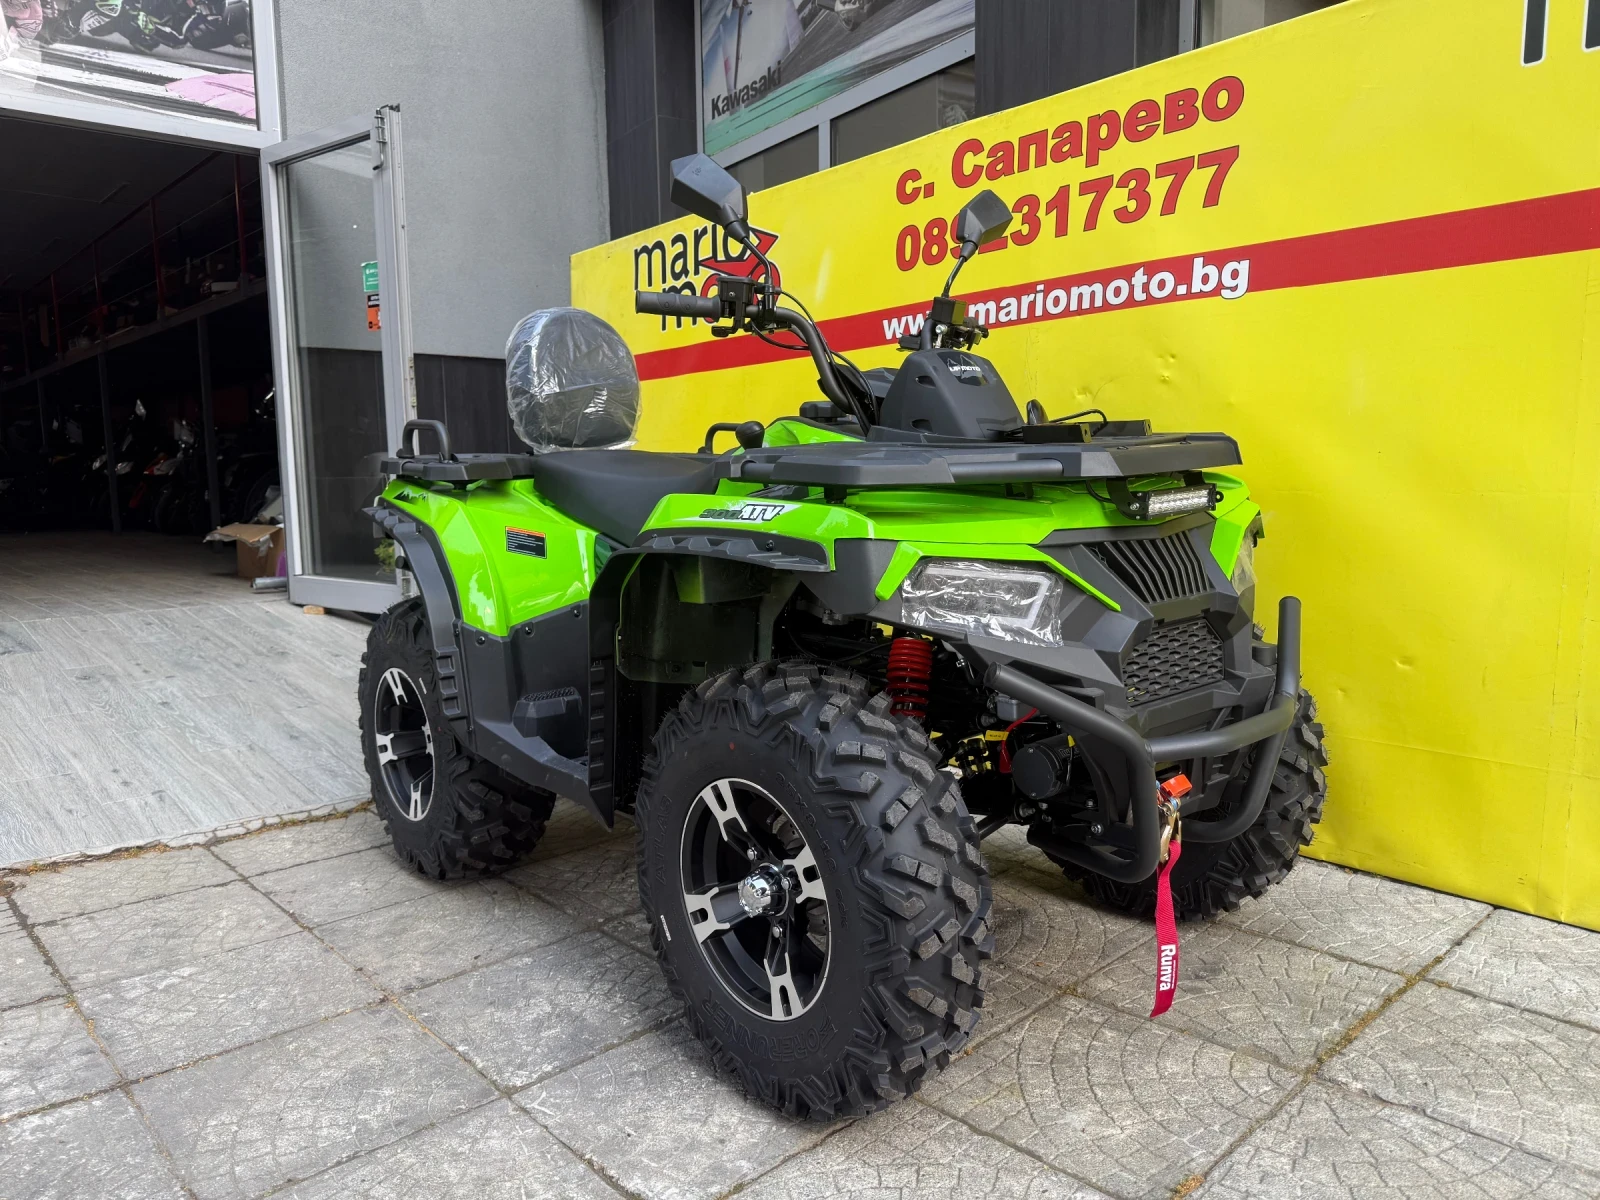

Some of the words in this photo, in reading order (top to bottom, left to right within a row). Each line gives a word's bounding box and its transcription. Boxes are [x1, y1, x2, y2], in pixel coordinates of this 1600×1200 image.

[711, 61, 782, 121] Kawasaki
[951, 75, 1245, 188] Сапарево
[896, 145, 1240, 272] 08317377
[882, 256, 1251, 341] wwmariomoto.bg
[1159, 944, 1176, 992] Runva
